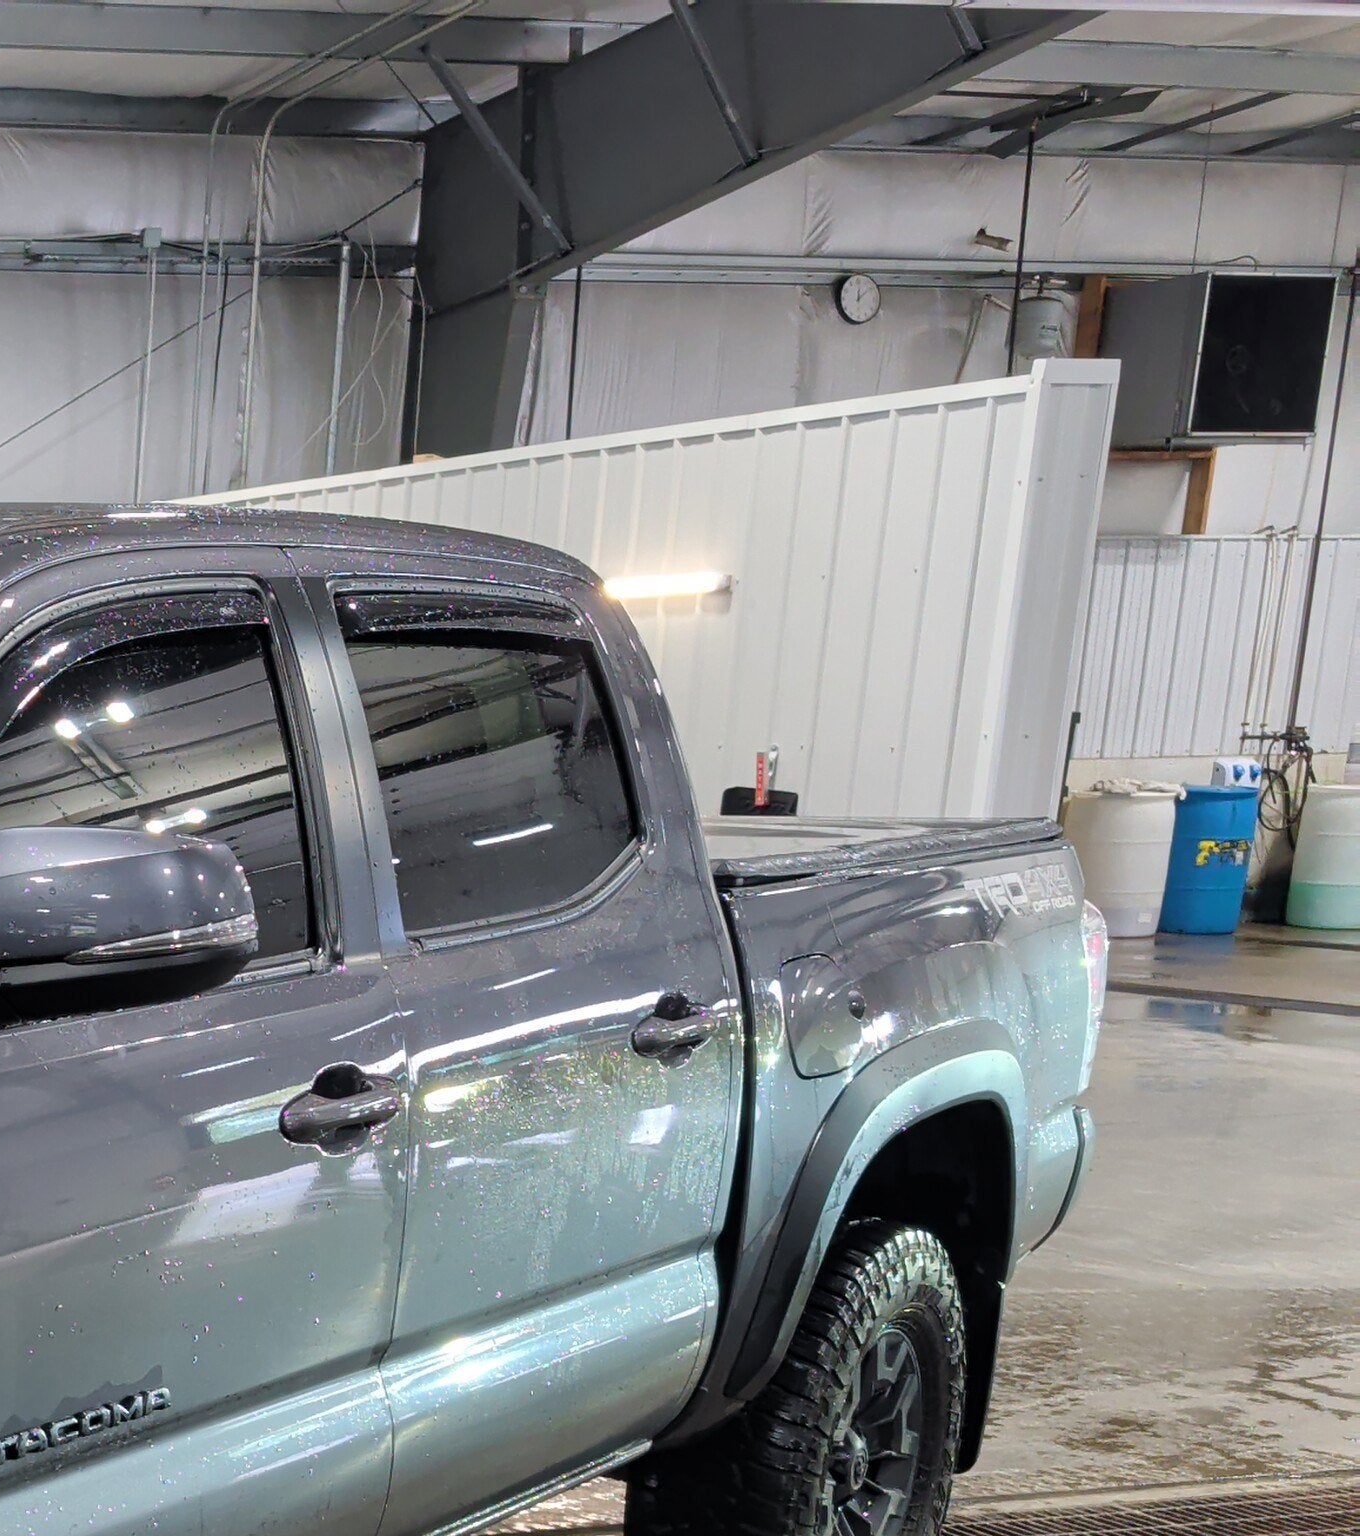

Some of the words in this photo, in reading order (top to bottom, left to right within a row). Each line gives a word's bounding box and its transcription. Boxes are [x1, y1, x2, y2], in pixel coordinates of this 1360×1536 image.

[963, 872, 1028, 919] TRD
[1031, 899, 1051, 913] OFF
[1051, 894, 1076, 909] ROAD
